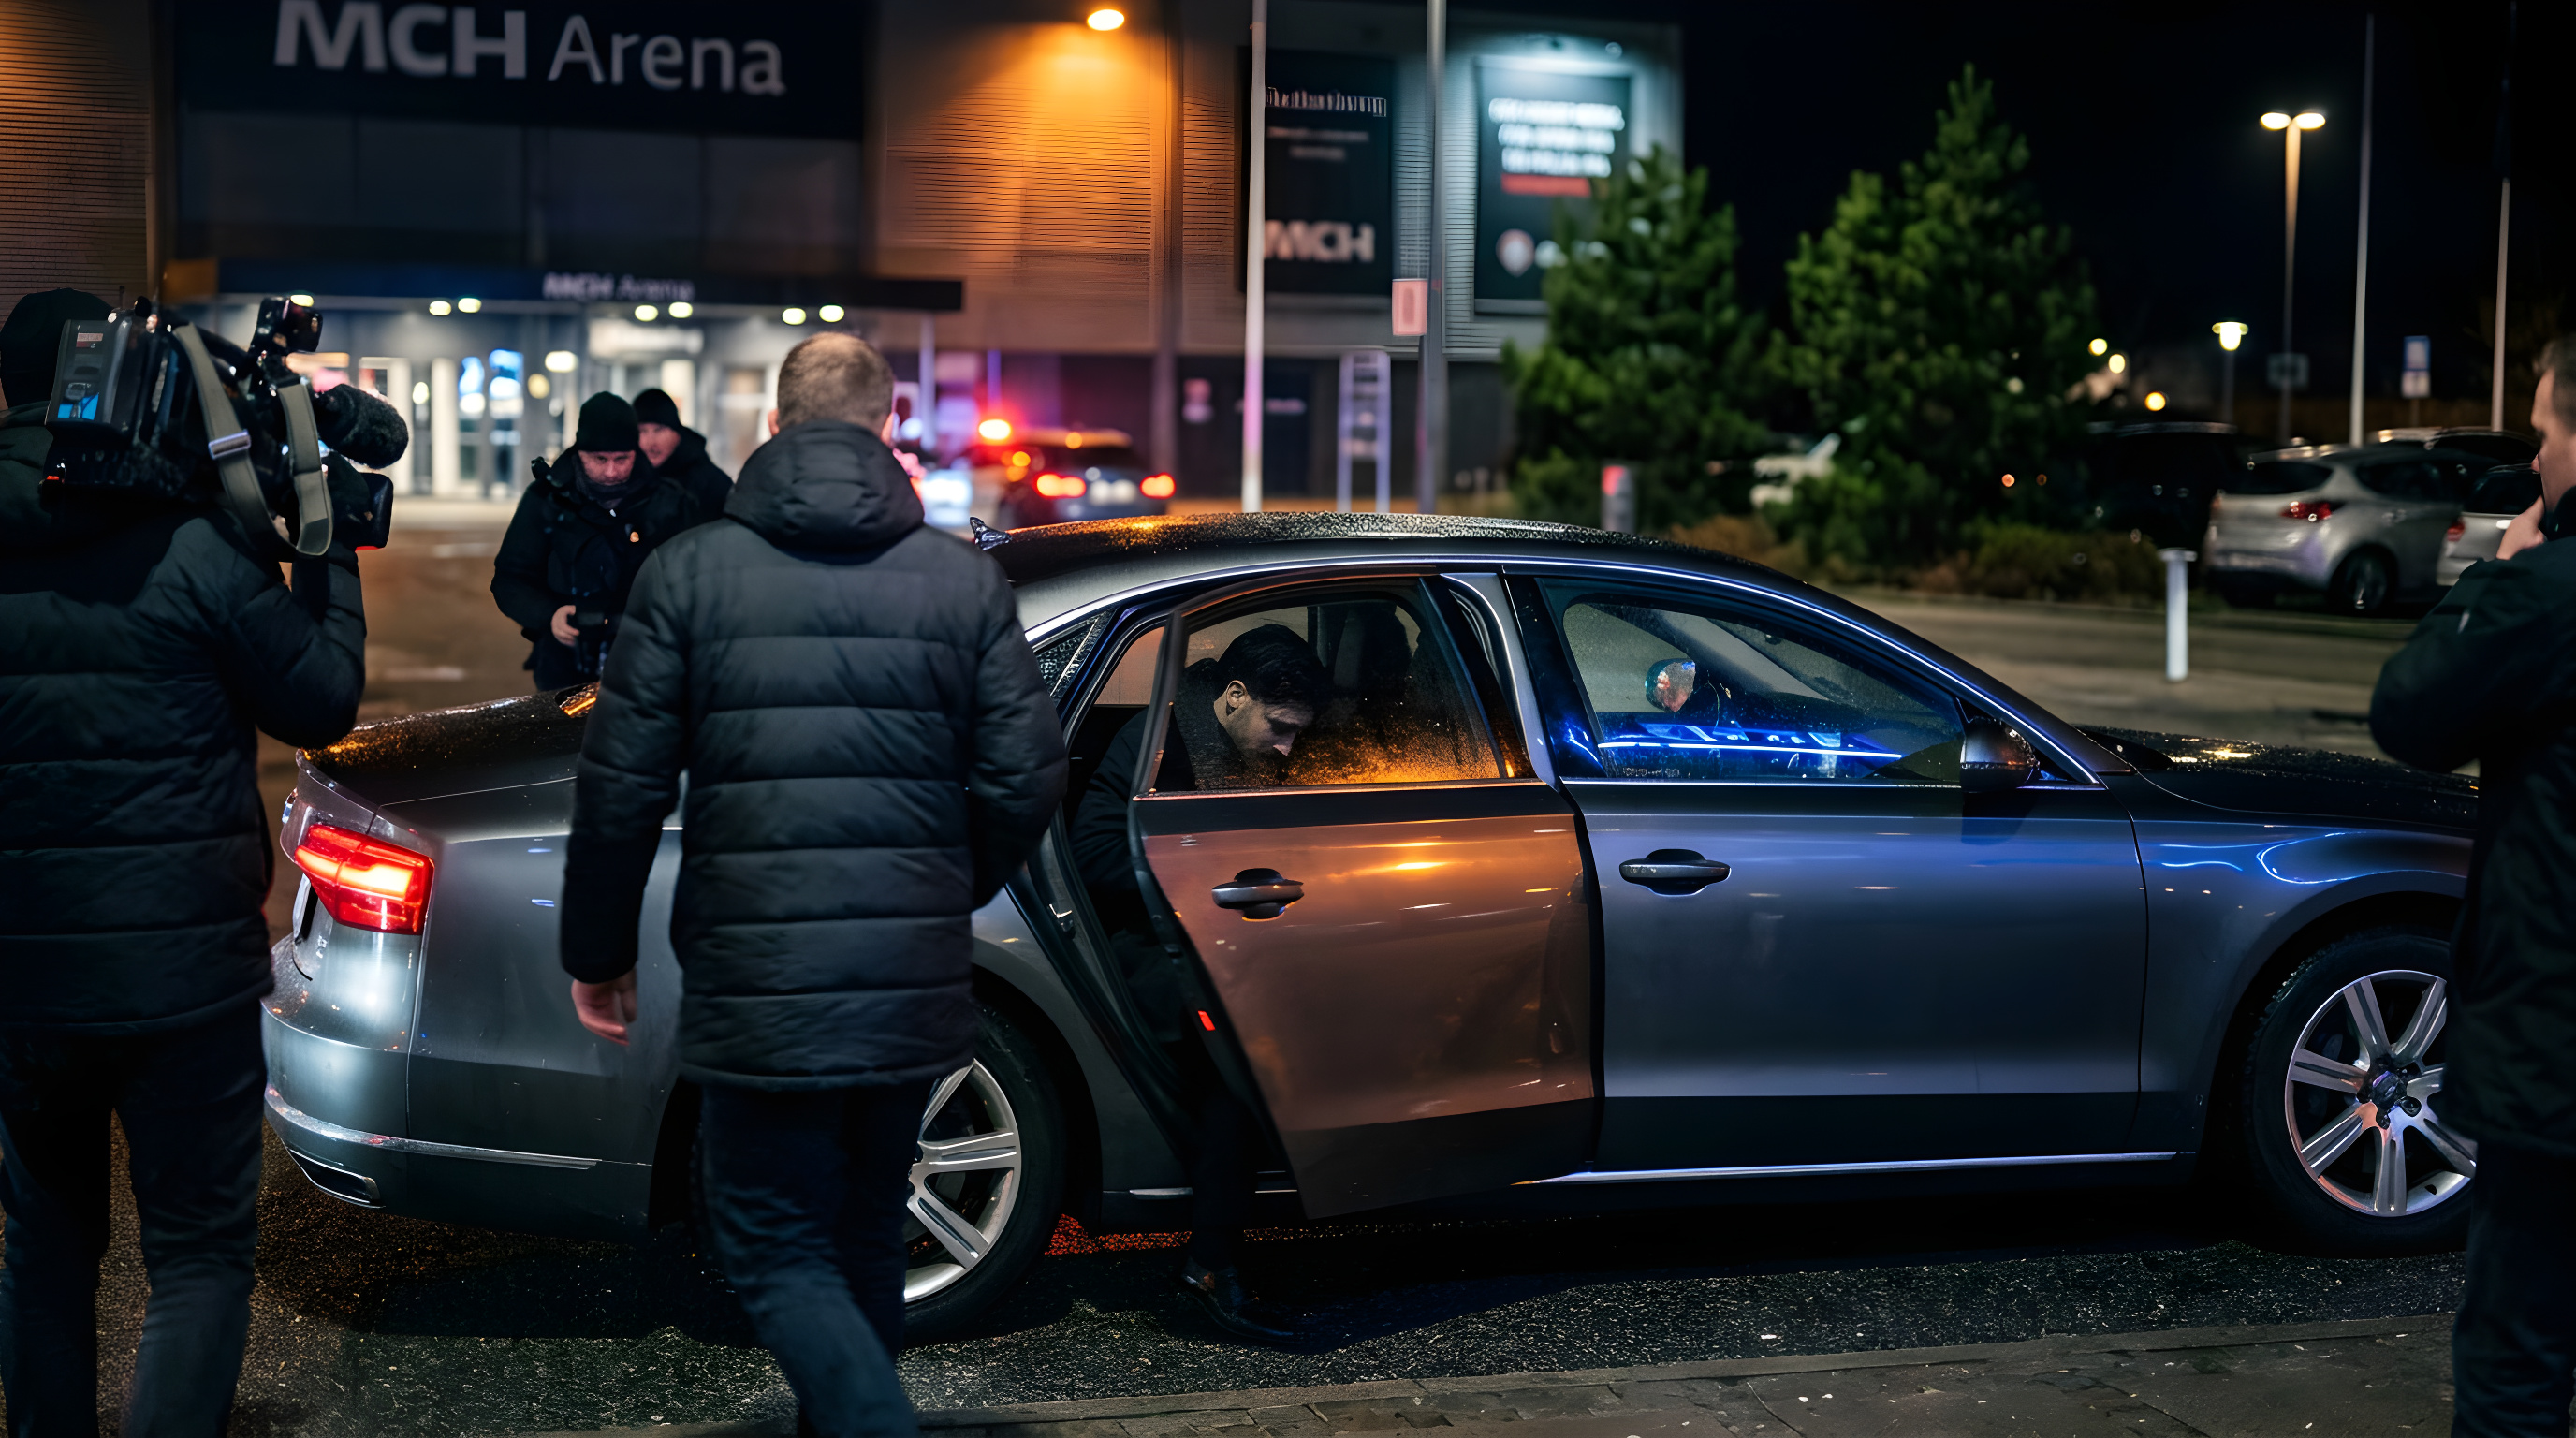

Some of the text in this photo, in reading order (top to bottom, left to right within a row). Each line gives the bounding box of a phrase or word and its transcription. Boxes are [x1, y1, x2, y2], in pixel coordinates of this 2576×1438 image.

[274, 0, 787, 95] MCH Arena
[1264, 219, 1375, 263] MCH
